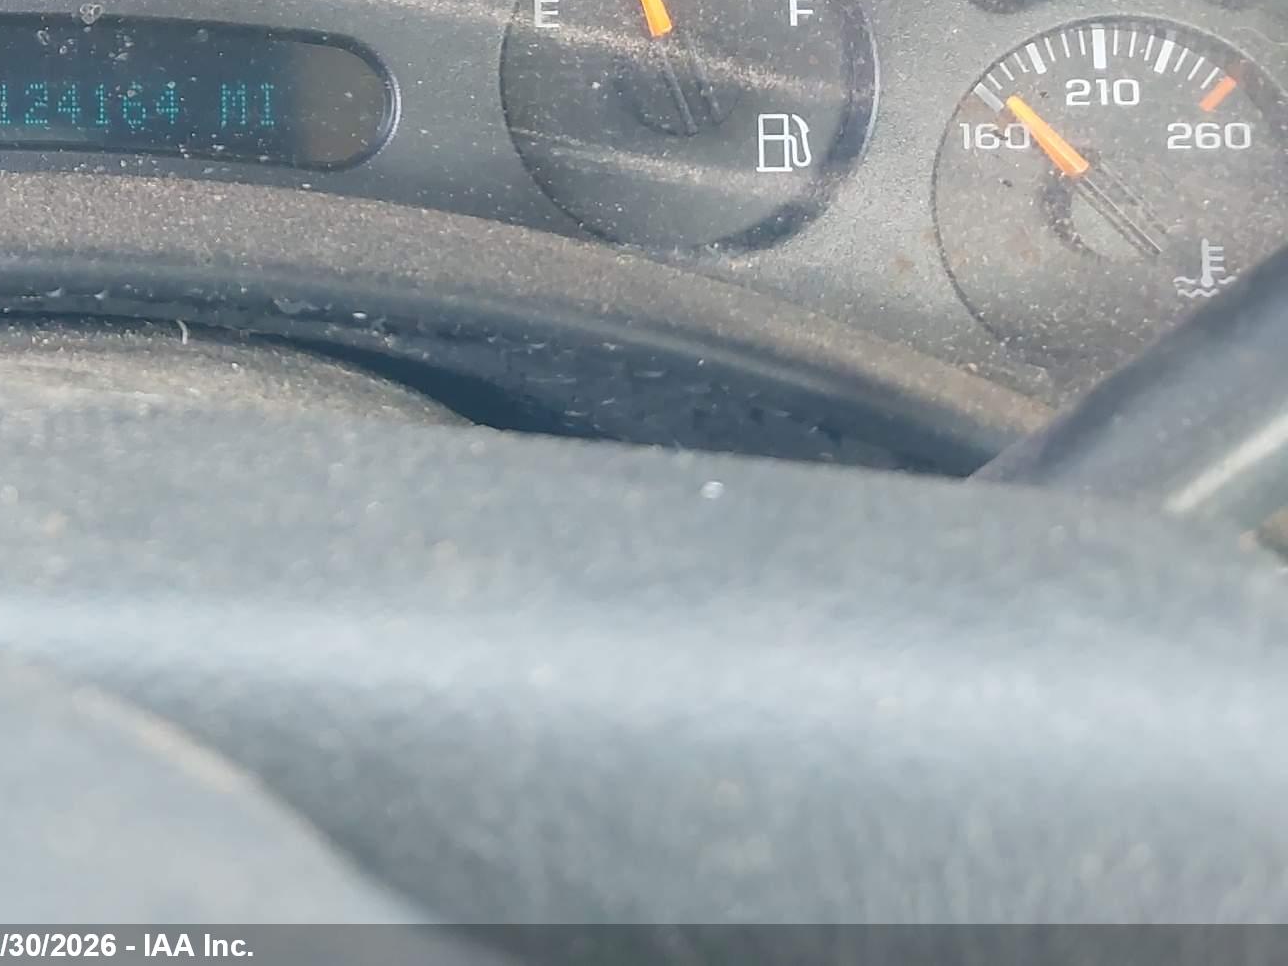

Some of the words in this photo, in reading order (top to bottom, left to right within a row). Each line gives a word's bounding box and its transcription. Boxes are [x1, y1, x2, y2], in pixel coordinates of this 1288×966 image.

[220, 84, 276, 125] MI
[1066, 79, 1140, 106] 210
[960, 123, 1030, 150] 160
[1167, 122, 1251, 150] 260
